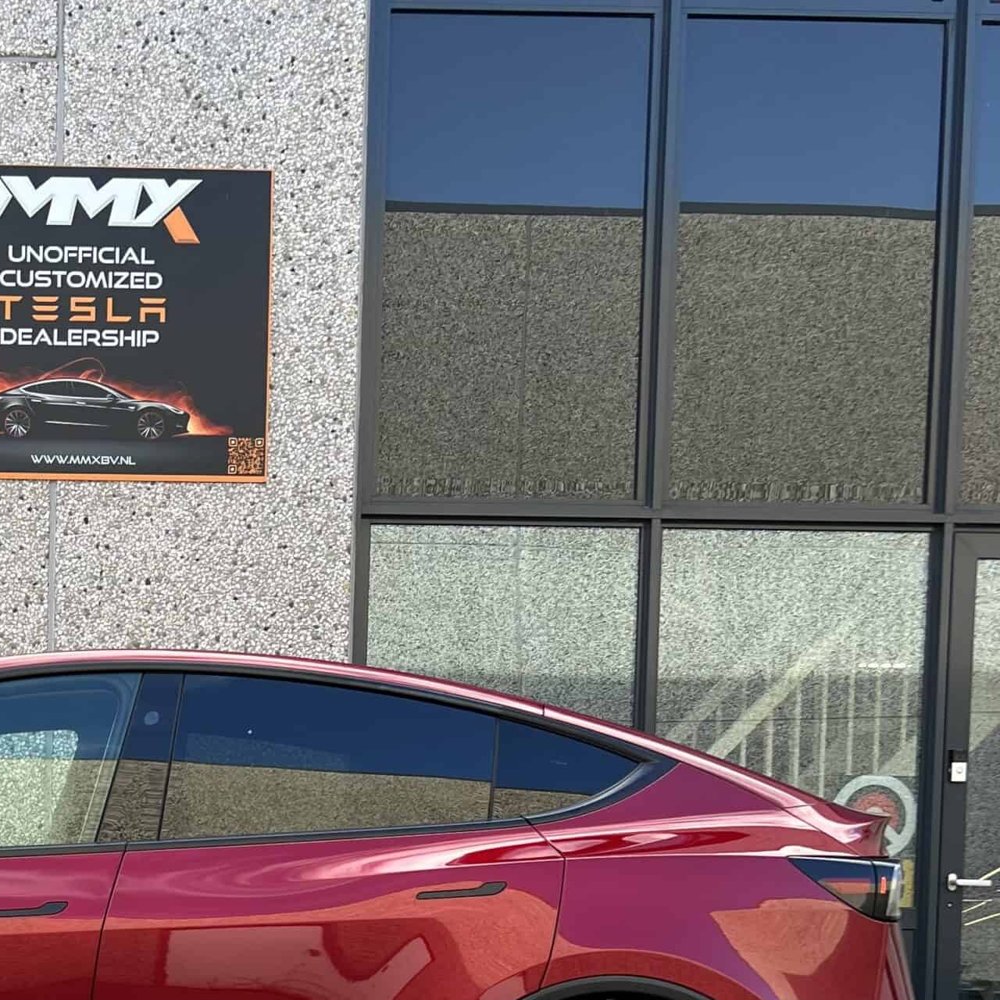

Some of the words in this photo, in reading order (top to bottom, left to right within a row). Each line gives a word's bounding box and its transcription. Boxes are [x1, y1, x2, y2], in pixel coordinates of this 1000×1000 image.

[8, 245, 155, 264] UNOFFICIAL
[0, 270, 163, 289] CUSTOMIZED
[0, 328, 159, 347] DEALERSHIP
[31, 454, 136, 466] WWW.MMXBV.NL
